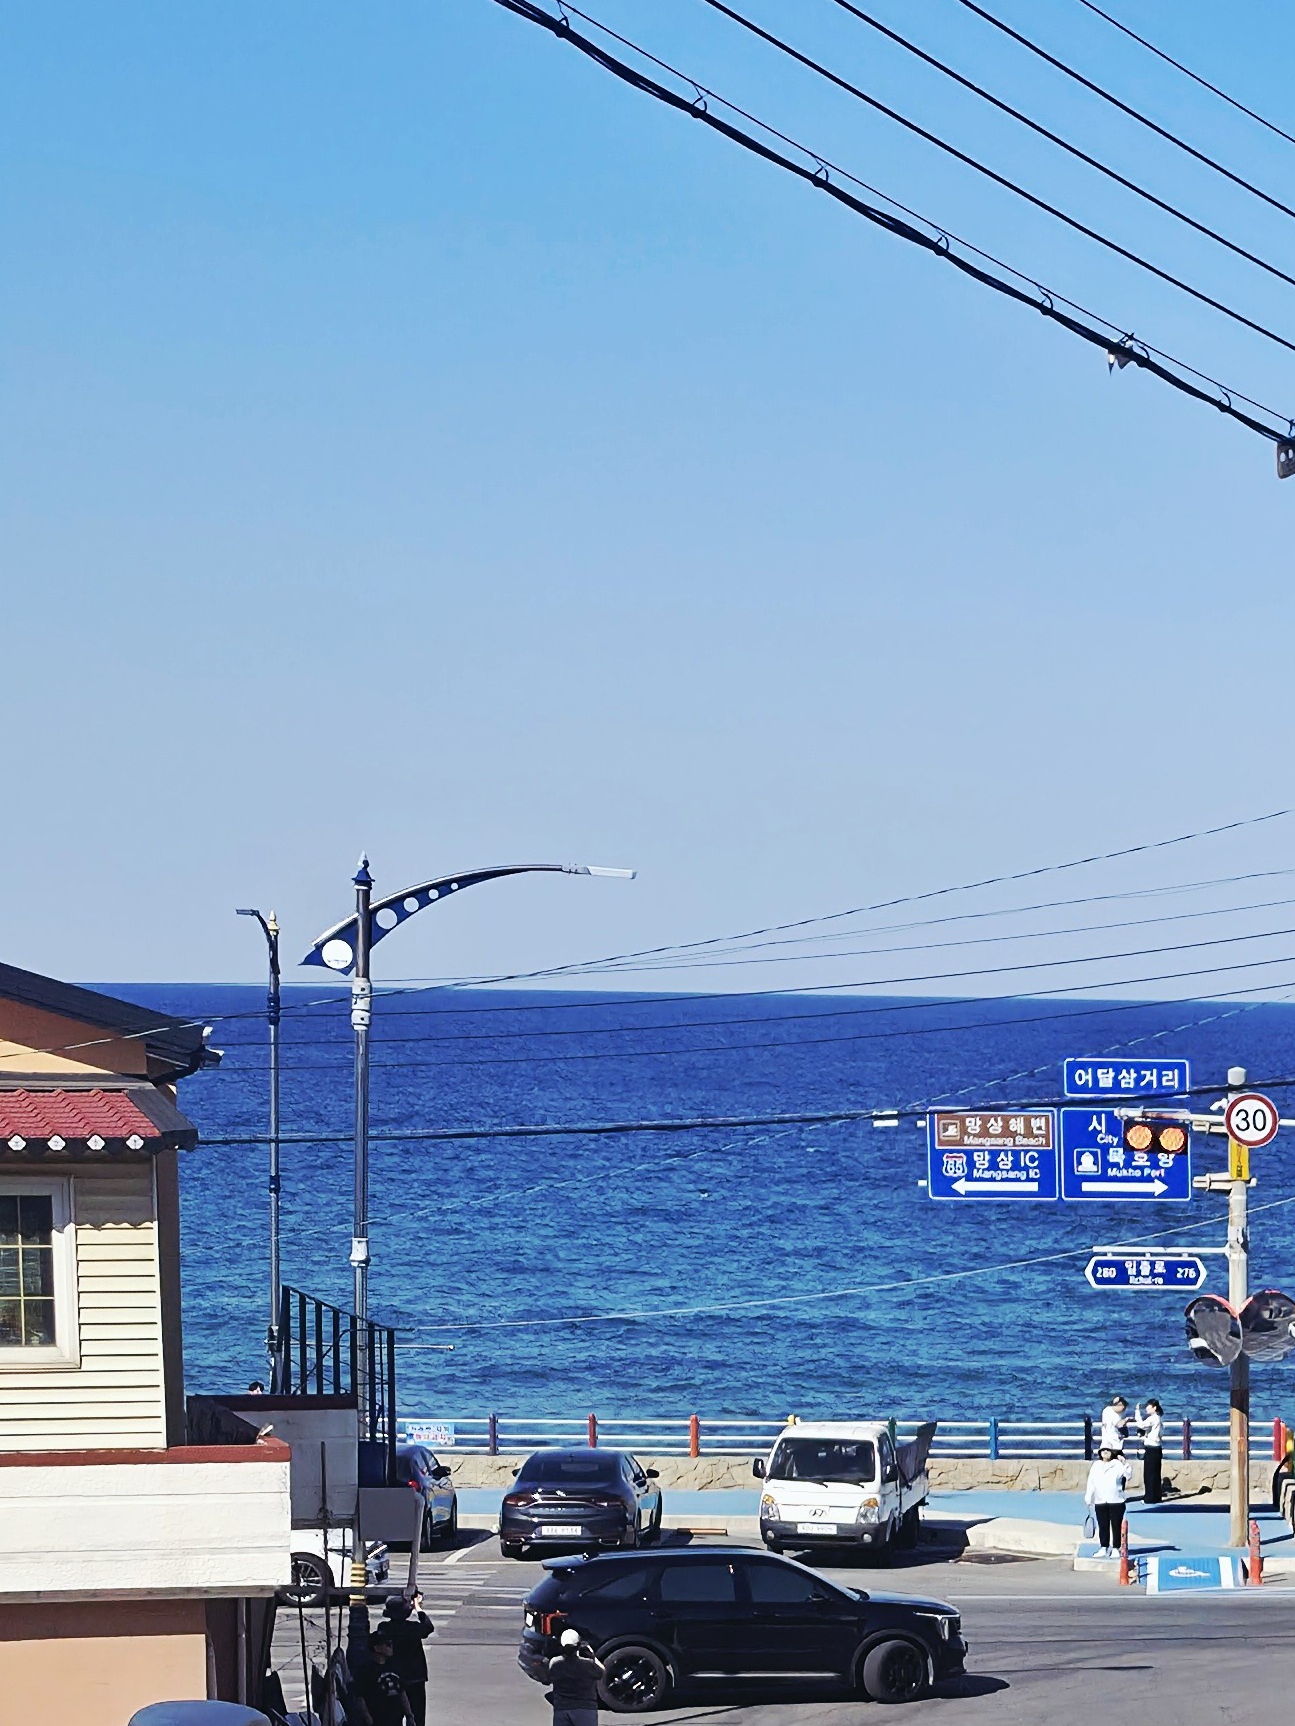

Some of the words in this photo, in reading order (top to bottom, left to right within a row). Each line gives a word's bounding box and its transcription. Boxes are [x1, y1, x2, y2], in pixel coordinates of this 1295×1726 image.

[1074, 1067, 1179, 1089] 어달삼거리
[965, 1116, 1046, 1135] 망상해변
[1235, 1108, 1267, 1132] 30
[1015, 1135, 1046, 1146] Beach
[1096, 1133, 1119, 1146] City
[946, 1158, 964, 1173] 65
[973, 1150, 1014, 1170] 망상
[1020, 1151, 1039, 1167] IC
[972, 1168, 1027, 1181] Mangsang
[1028, 1169, 1041, 1179] IC
[1107, 1167, 1142, 1178] Mukho
[1143, 1167, 1165, 1178] Port
